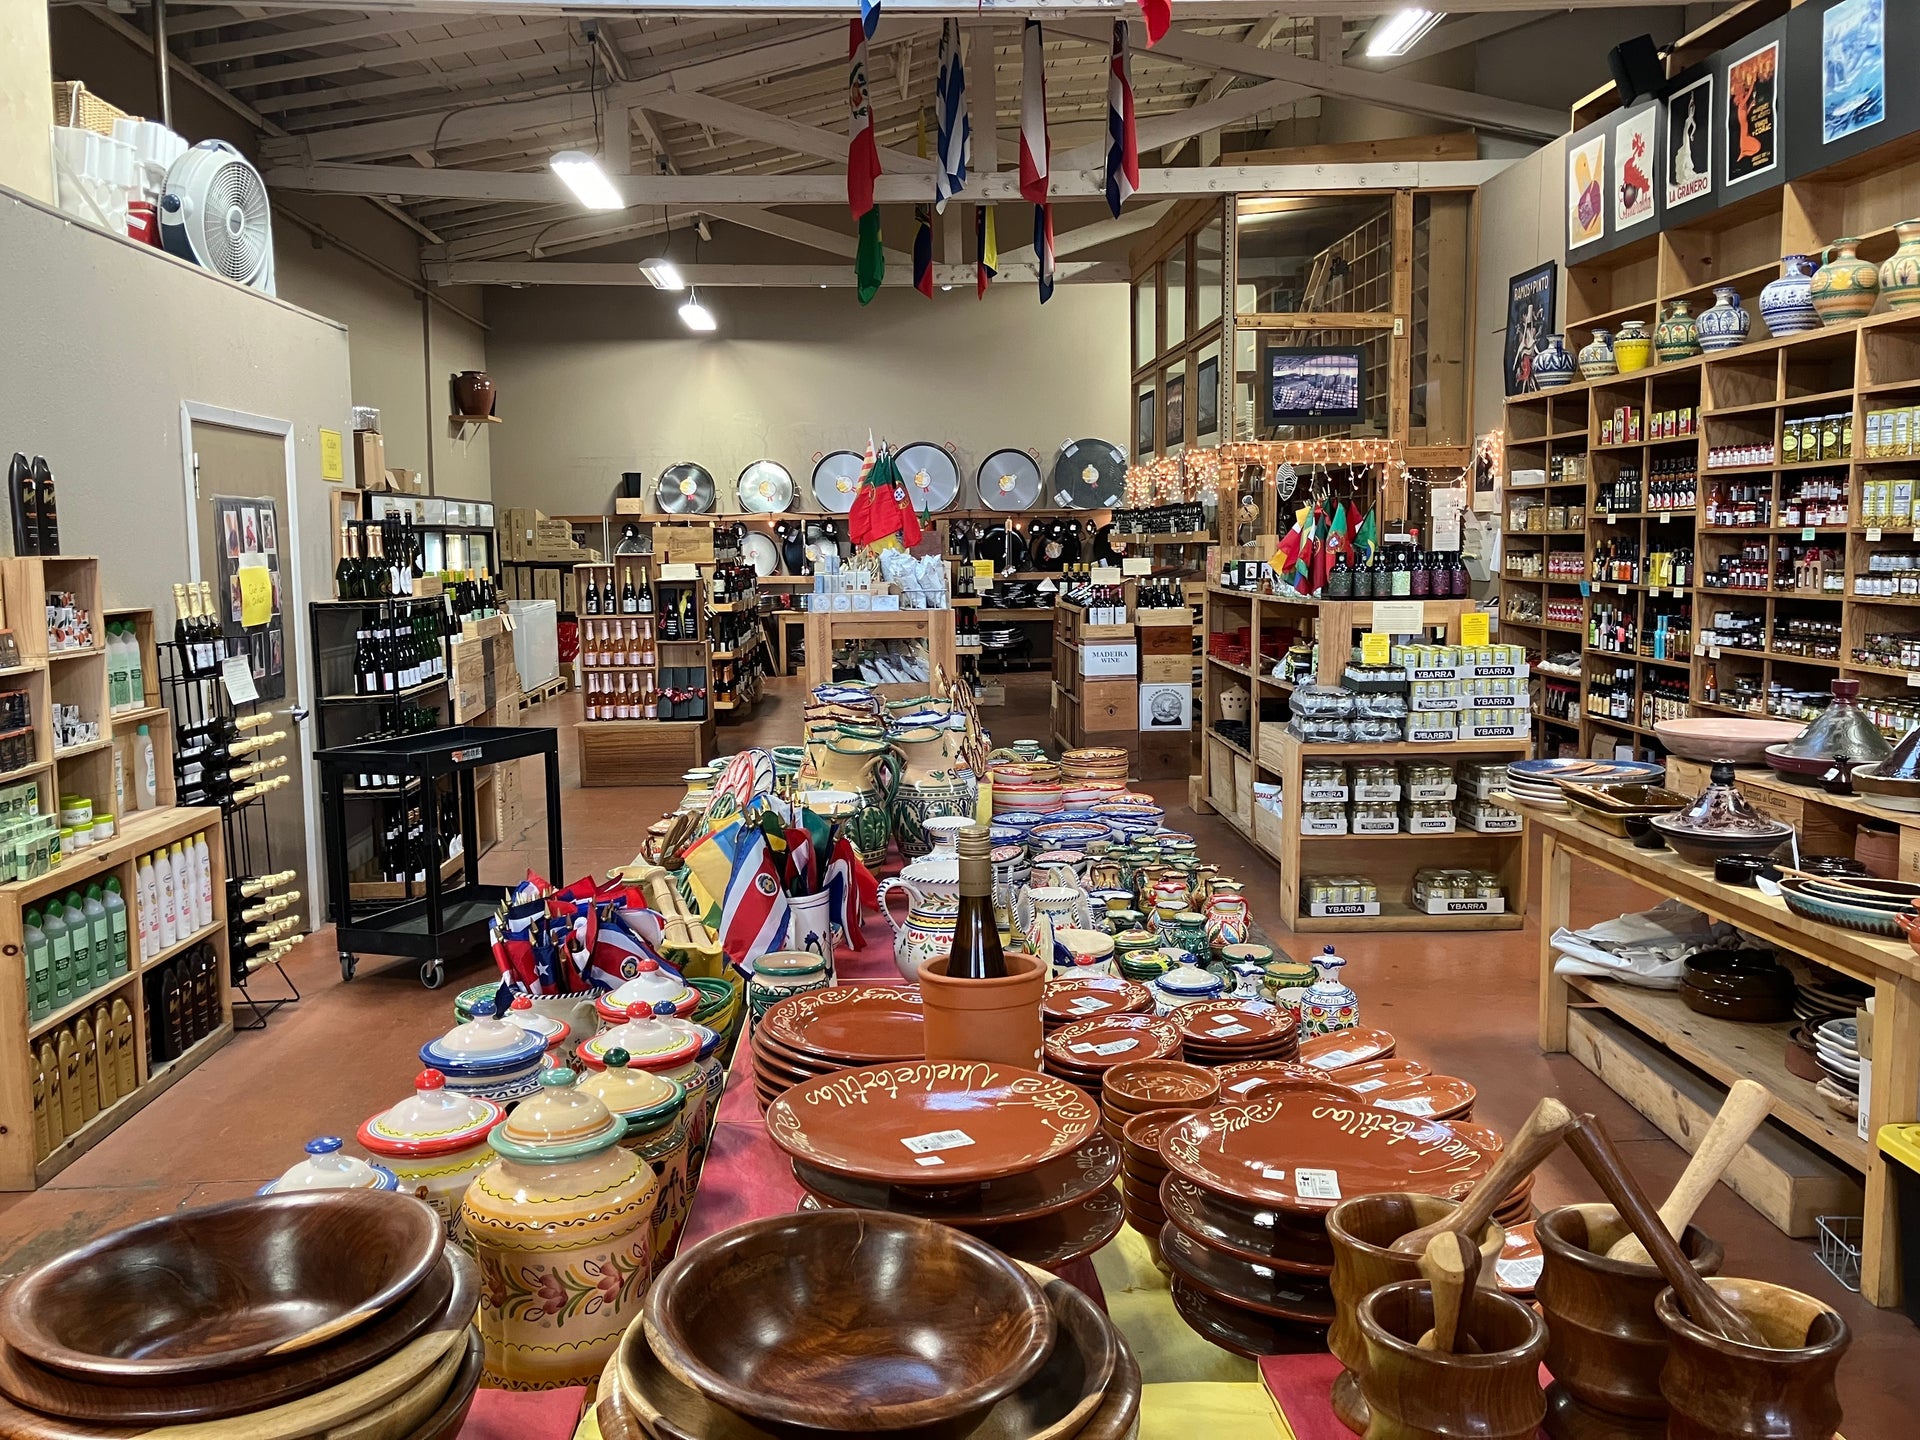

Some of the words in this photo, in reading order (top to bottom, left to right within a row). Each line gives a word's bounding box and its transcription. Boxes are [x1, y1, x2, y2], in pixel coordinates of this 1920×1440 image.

[1669, 191, 1676, 203] LA
[1677, 177, 1708, 200] GRANERO
[1532, 275, 1549, 294] PINTO
[1416, 671, 1454, 679] YBARRA
[1476, 667, 1513, 675] YBARRA
[1476, 727, 1513, 735] YBARRA
